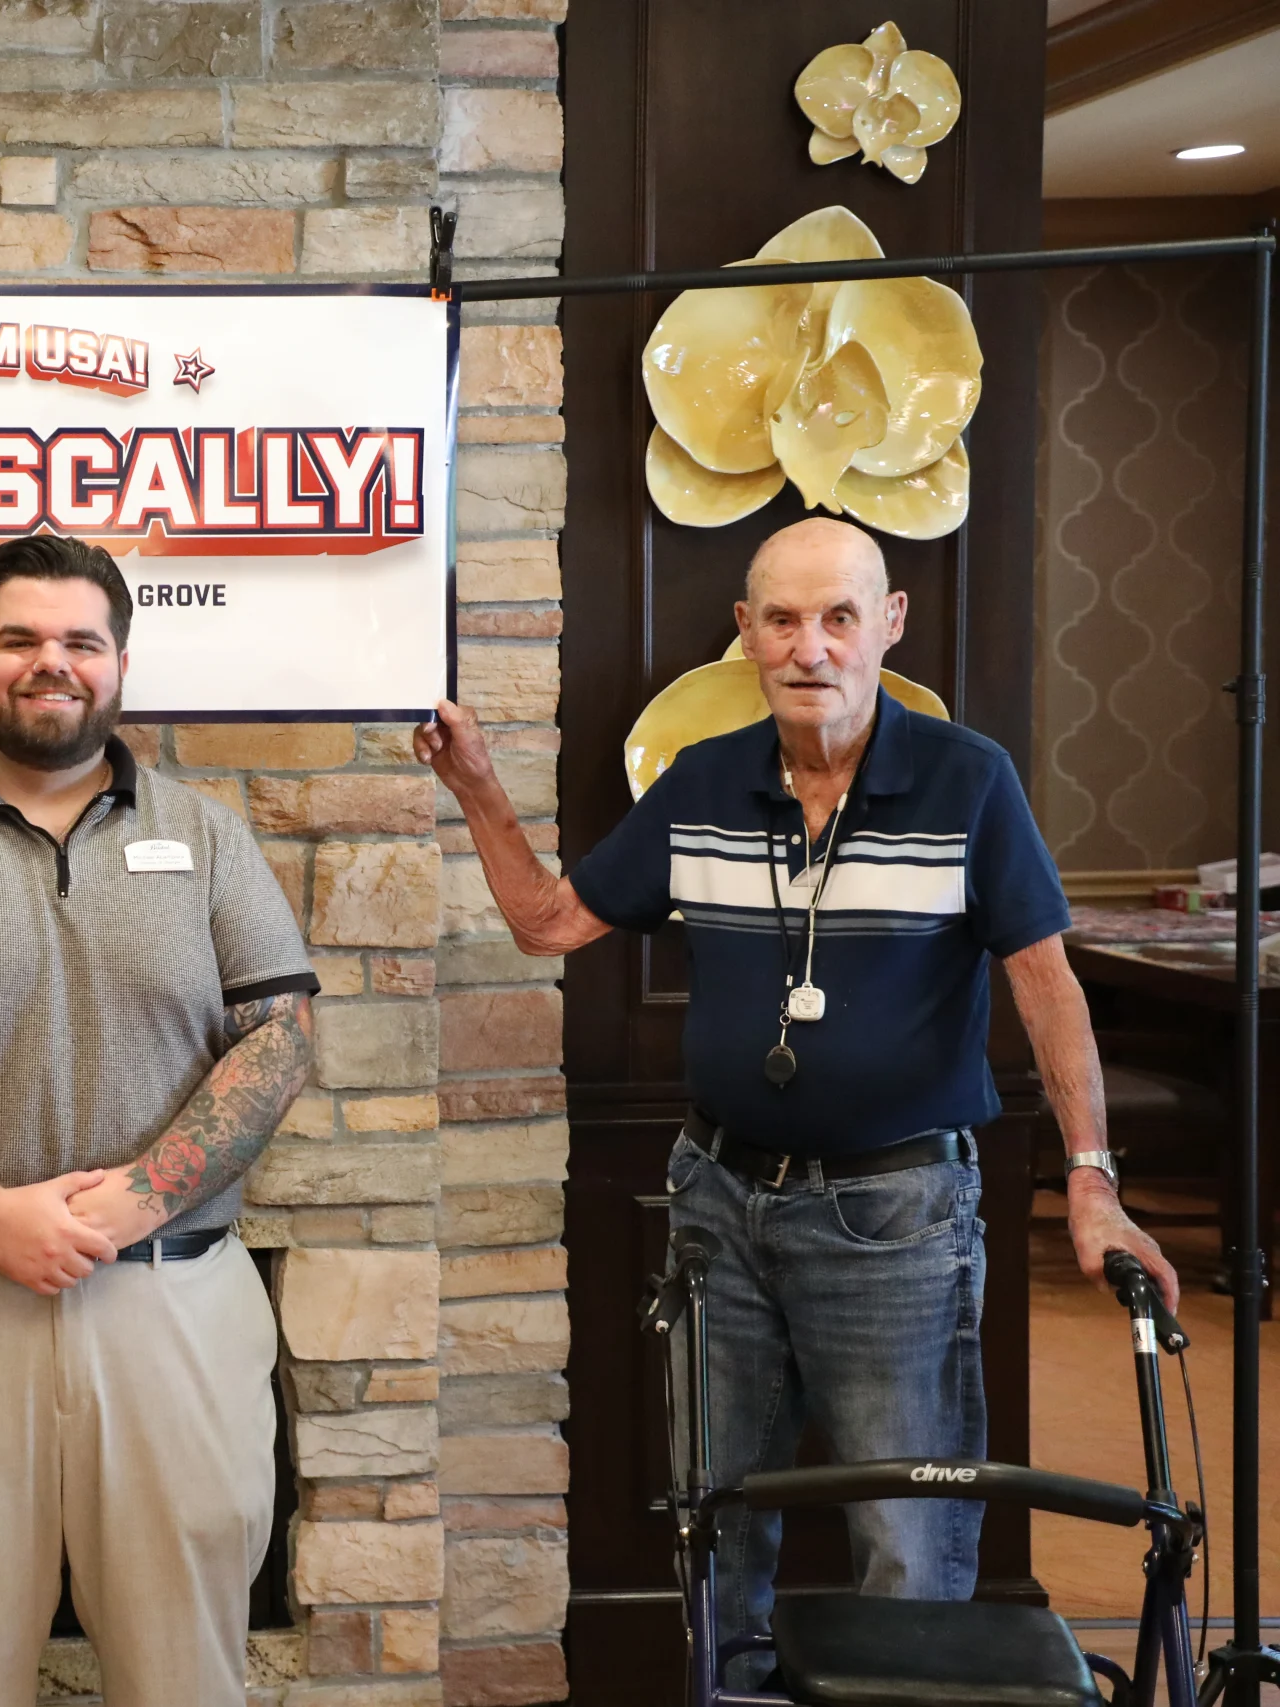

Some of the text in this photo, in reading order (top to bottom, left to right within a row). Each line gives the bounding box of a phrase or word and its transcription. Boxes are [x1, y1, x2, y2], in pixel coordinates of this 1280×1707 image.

[28, 324, 150, 394] USA!
[137, 584, 227, 607] GROVE
[910, 1462, 977, 1483] drive
